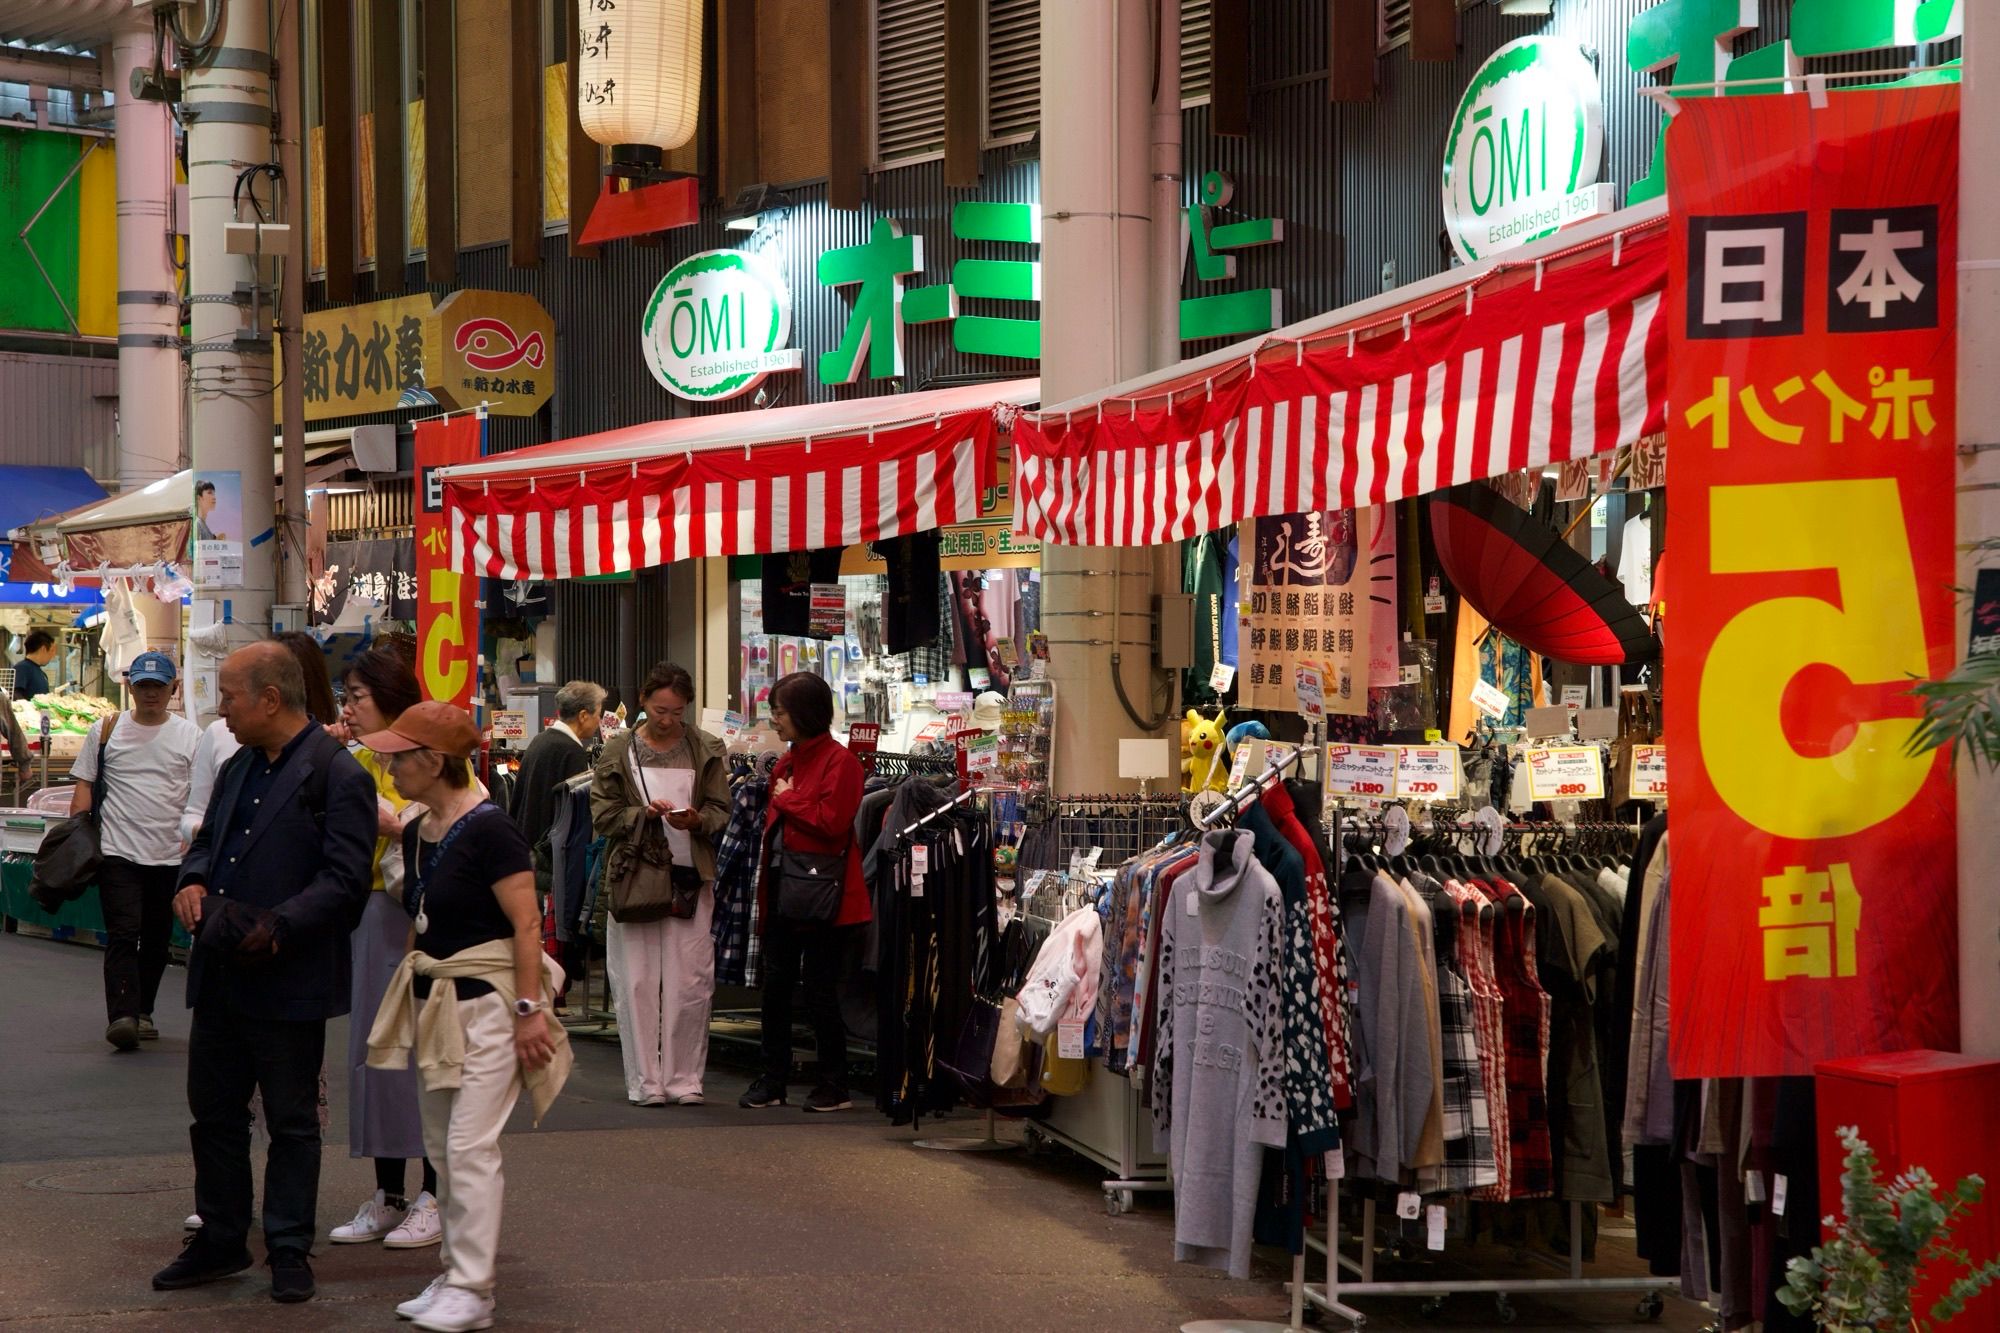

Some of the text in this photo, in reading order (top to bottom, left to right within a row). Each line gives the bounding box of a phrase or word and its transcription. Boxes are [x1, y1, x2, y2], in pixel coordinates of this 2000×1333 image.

[1469, 100, 1546, 217] ŌMI
[1489, 190, 1595, 244] Established 1961
[670, 287, 745, 360] ŌMI
[690, 351, 790, 378] Established 1961
[473, 376, 536, 396] 新力水産
[851, 728, 877, 741] SALE
[1331, 746, 1350, 756] SALE
